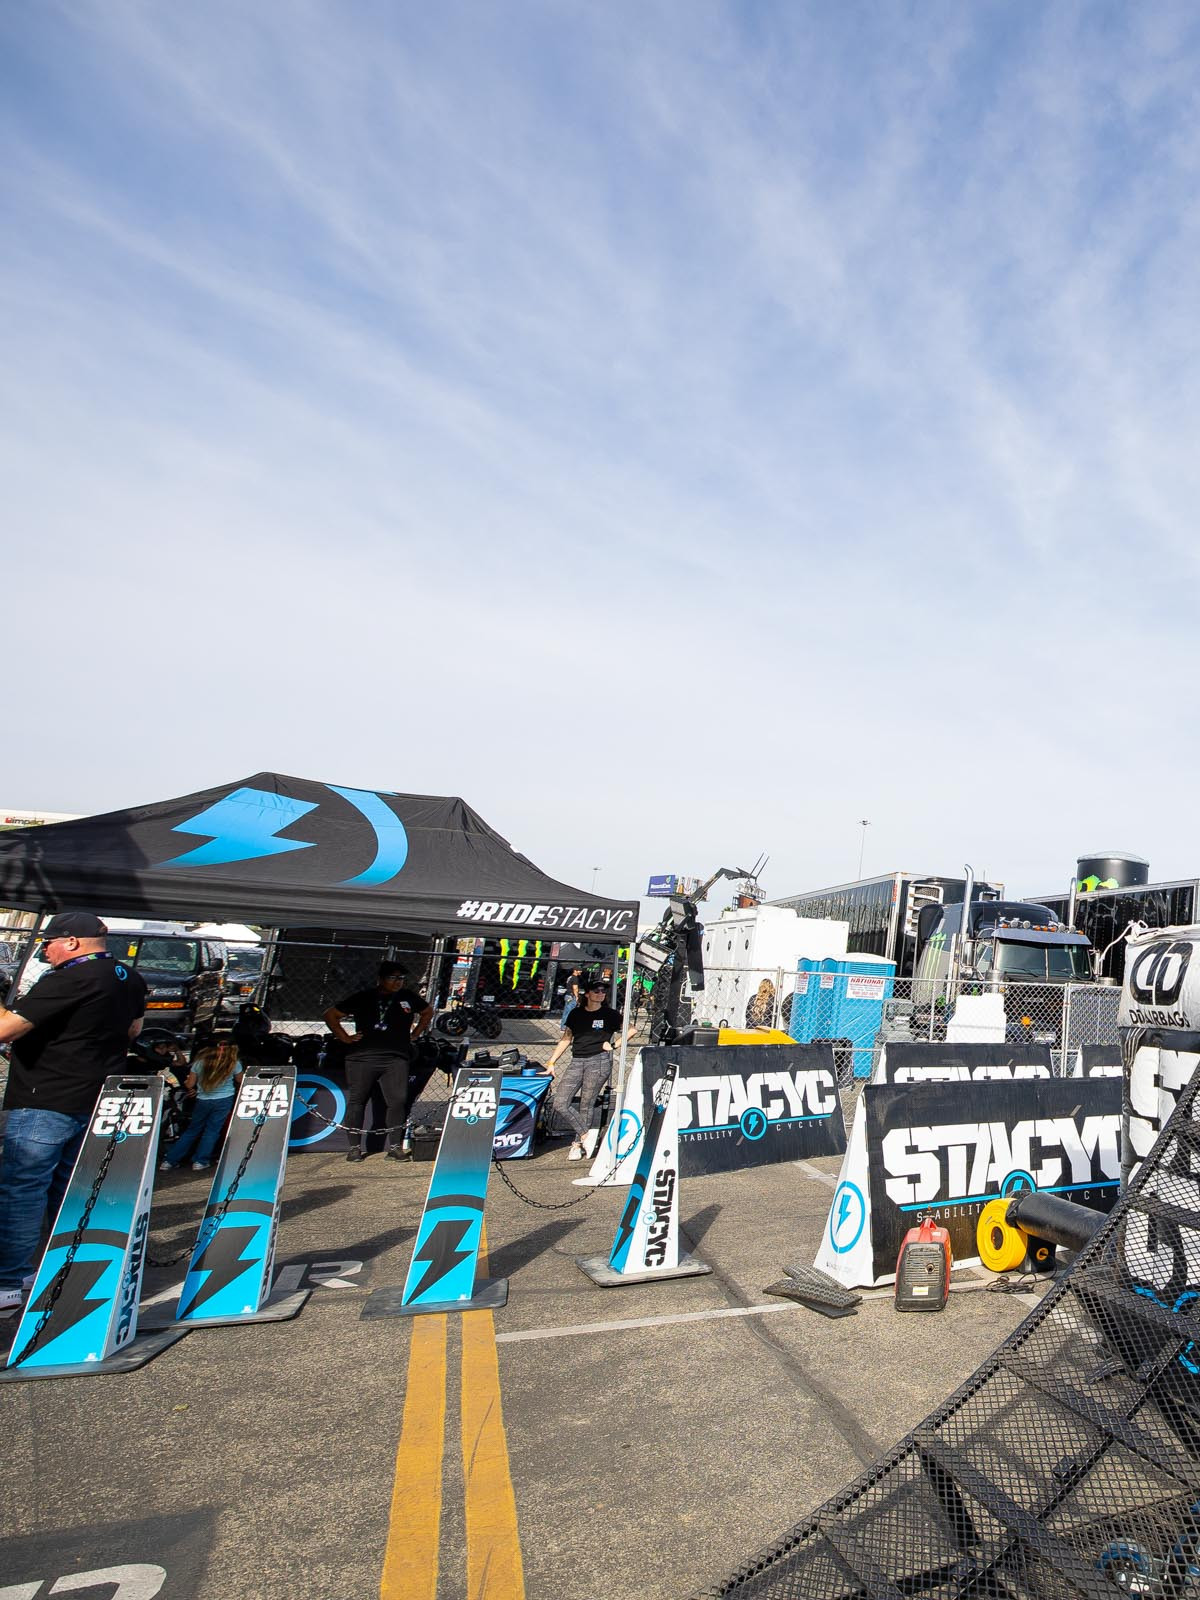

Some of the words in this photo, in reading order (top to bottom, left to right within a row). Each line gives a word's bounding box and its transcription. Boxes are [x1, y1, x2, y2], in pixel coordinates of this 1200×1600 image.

[456, 900, 634, 931] #RIDESTACYC
[1128, 1009, 1191, 1028] DDAIRBAGS
[240, 1084, 288, 1100] STA
[455, 1087, 497, 1103] STA
[451, 1102, 497, 1118] CYC
[776, 1119, 823, 1132] CYCLE
